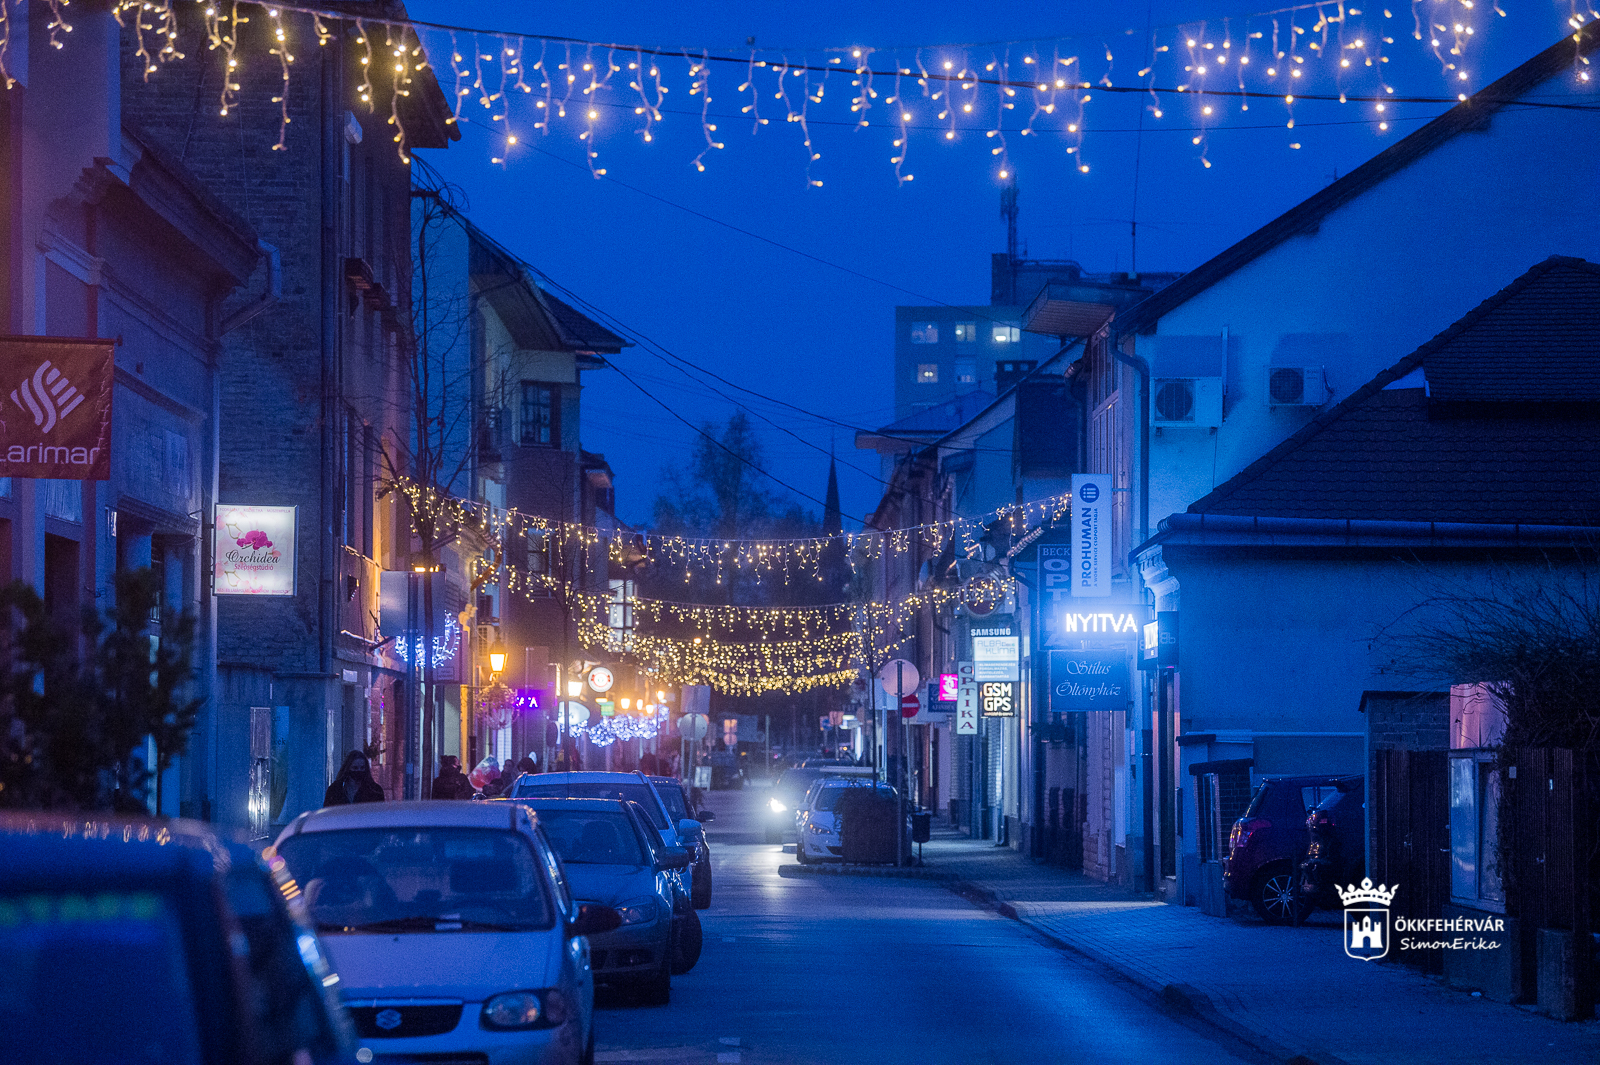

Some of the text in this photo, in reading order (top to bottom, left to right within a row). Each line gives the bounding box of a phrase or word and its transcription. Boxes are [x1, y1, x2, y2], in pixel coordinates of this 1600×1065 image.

[1042, 547, 1071, 556] BECK
[1081, 507, 1092, 587] PROHUMAN
[225, 549, 280, 563] Orchidea
[1066, 613, 1138, 633] NYITVA
[971, 628, 1011, 636] SAMSUNG
[1066, 660, 1112, 675] Stílus
[983, 682, 1012, 697] GSM
[1056, 680, 1121, 700] Öltönyház
[960, 665, 976, 730] OPTIKA
[984, 697, 1012, 712] GPS
